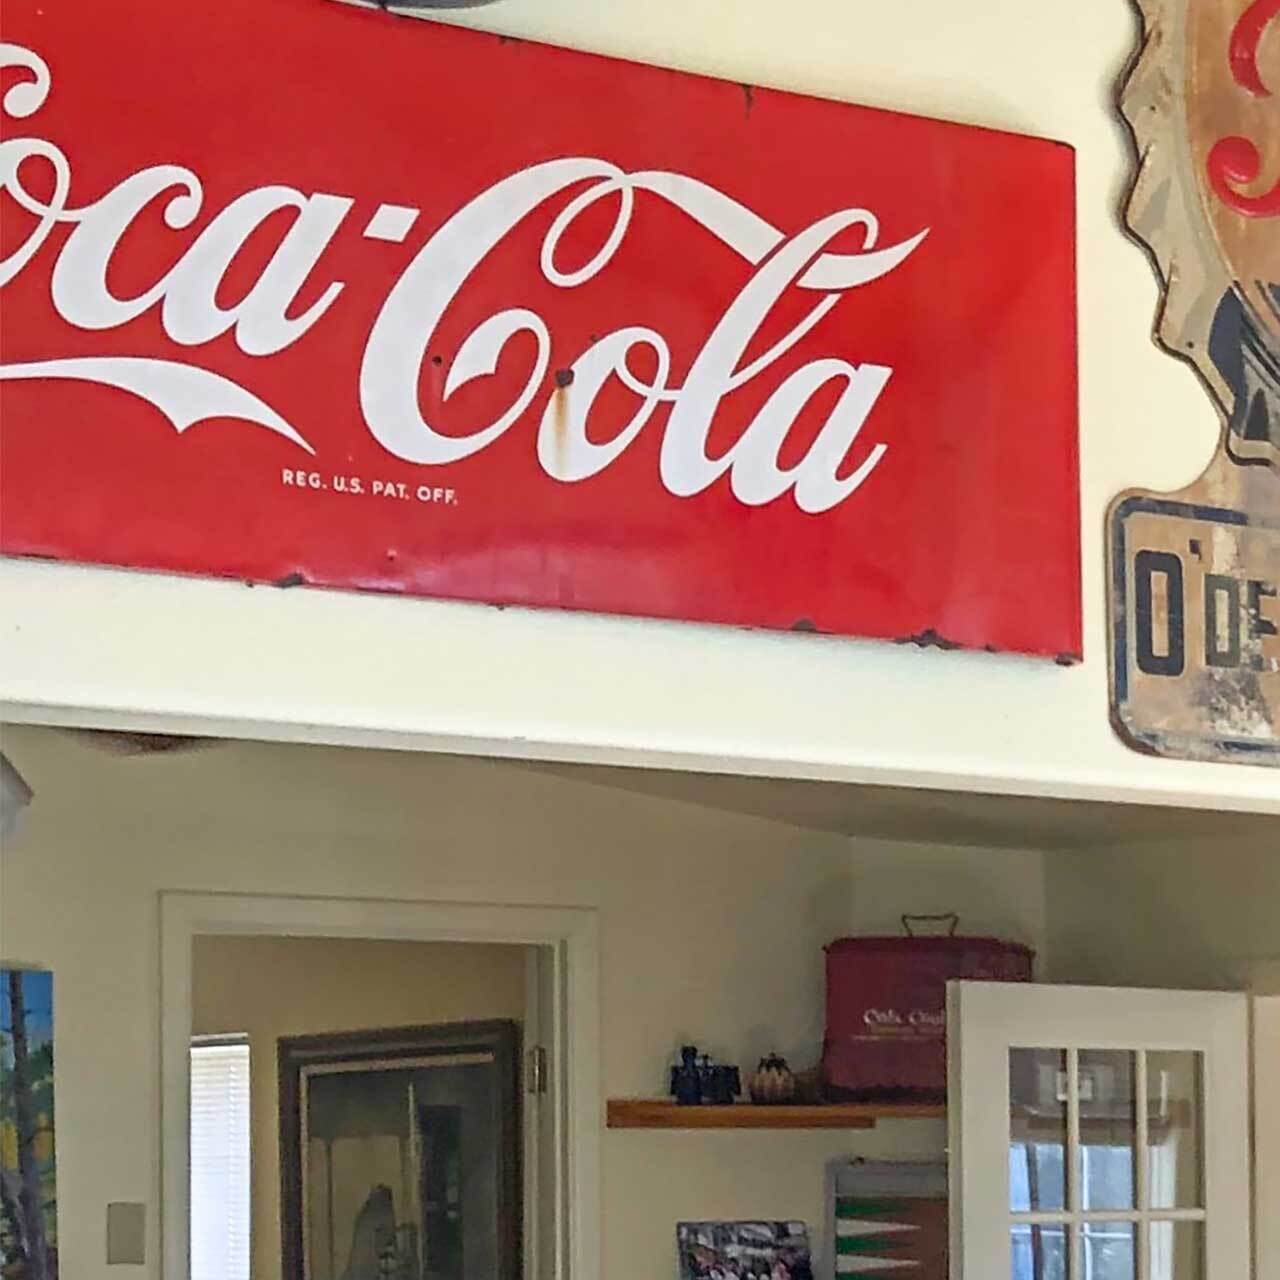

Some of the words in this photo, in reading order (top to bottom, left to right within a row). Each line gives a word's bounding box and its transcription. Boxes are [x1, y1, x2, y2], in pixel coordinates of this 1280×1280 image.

[0, 42, 930, 514] oca-Cola
[282, 468, 328, 489] REG.
[333, 476, 365, 494] U.S.
[372, 481, 410, 500] PAT.
[416, 486, 458, 506] OFF.
